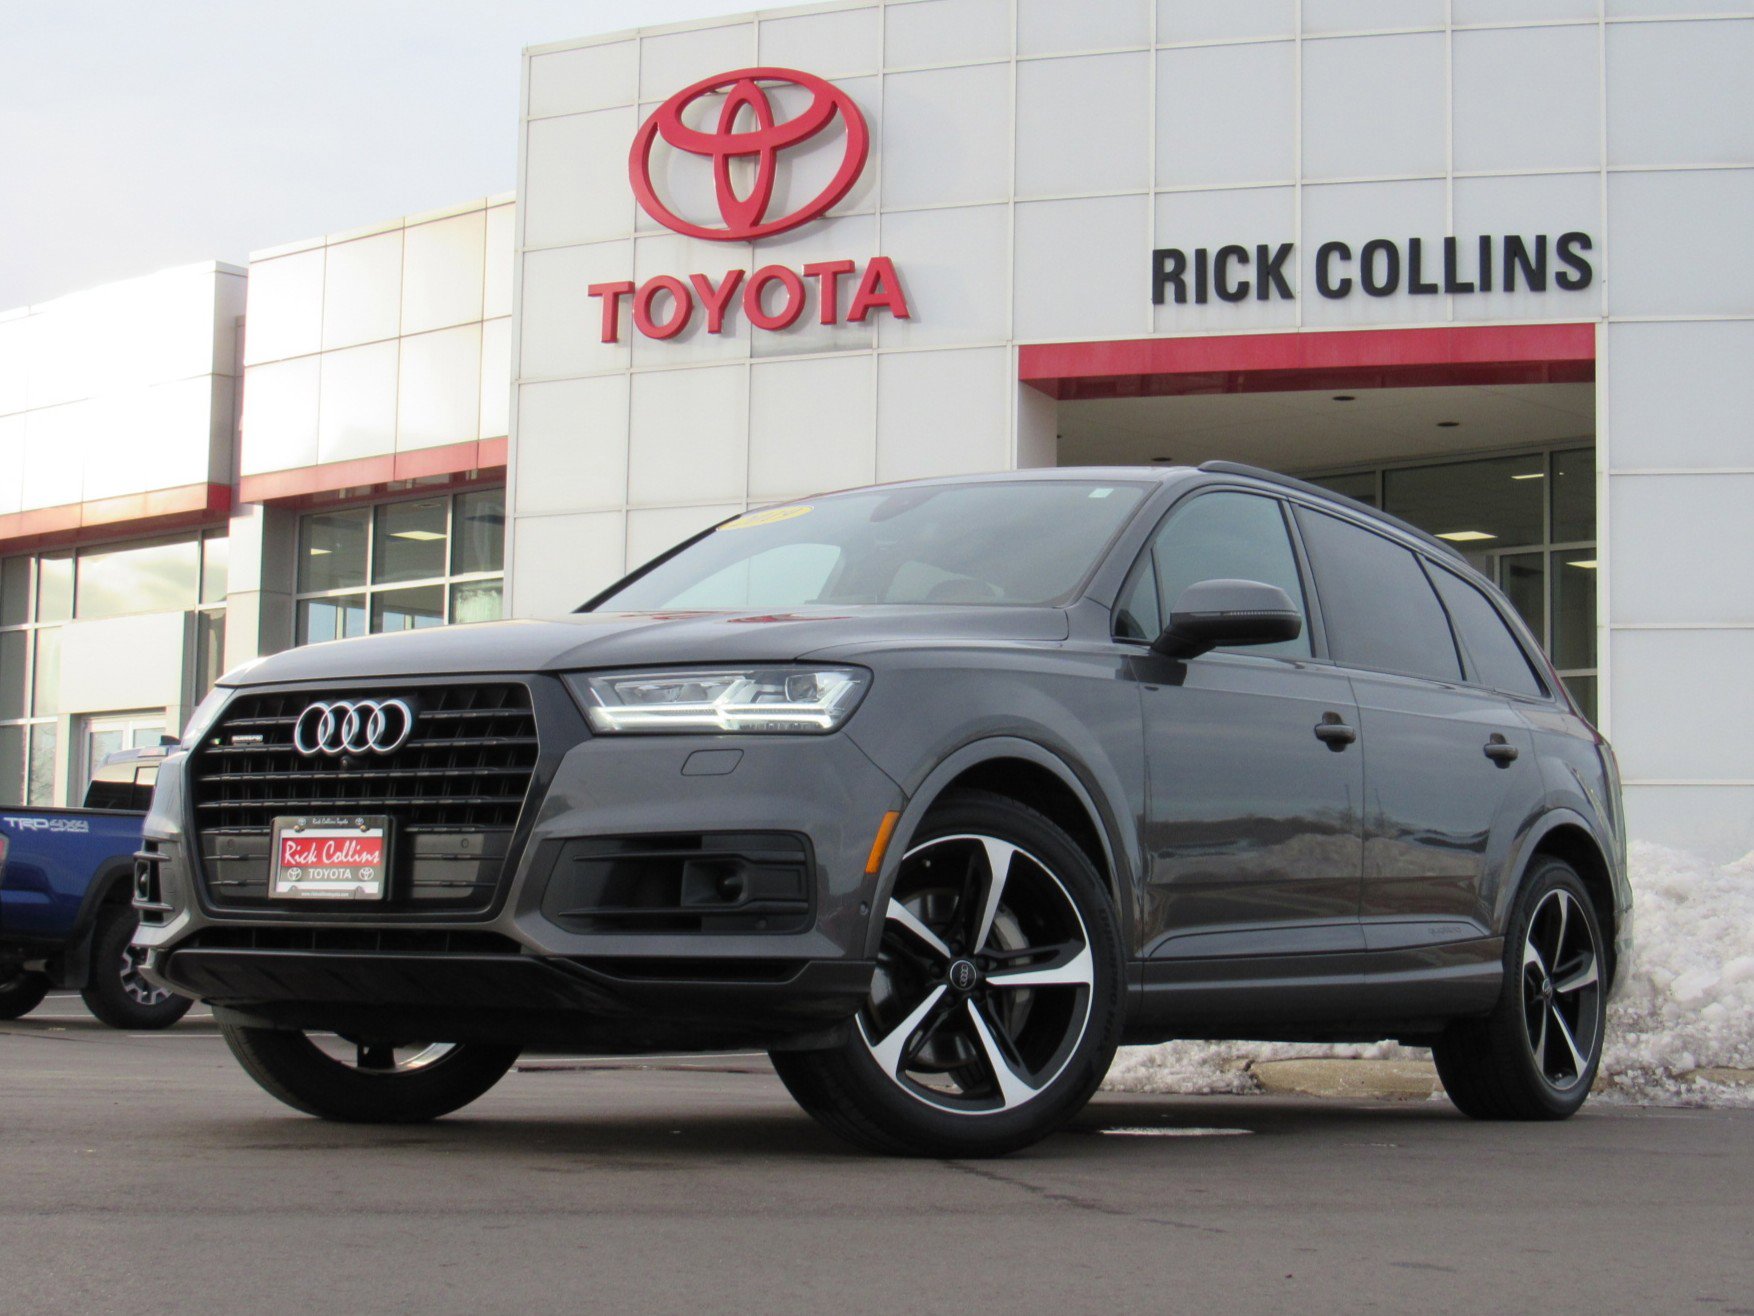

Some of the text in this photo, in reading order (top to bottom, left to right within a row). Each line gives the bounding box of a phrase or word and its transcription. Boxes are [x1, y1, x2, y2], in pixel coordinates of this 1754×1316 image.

[1151, 231, 1593, 305] RICK COLLINS
[588, 256, 911, 343] TOYOTA
[3, 817, 49, 831] TRD
[285, 839, 380, 865] Rick Collins
[308, 868, 352, 879] TOYOTA
